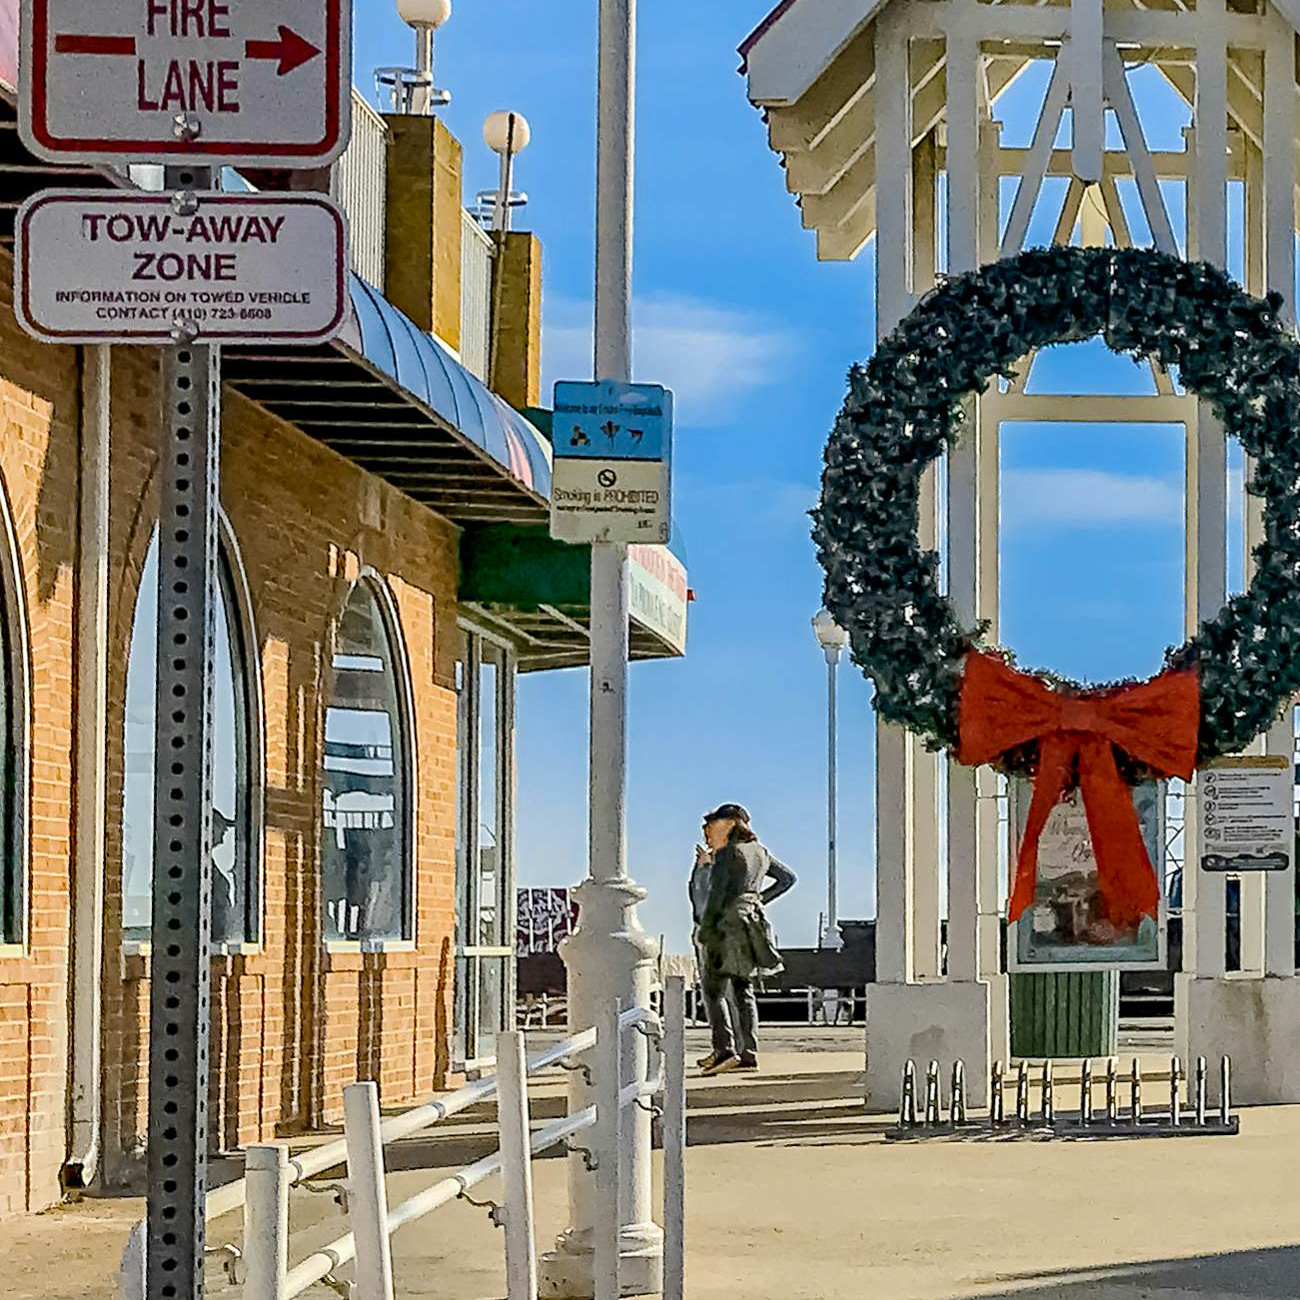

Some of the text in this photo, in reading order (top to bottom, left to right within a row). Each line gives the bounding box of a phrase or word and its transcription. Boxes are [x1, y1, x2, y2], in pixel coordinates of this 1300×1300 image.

[136, 60, 240, 113] LANE
[82, 213, 286, 243] TOW-AWAY
[132, 252, 237, 281] ZONE
[56, 290, 311, 305] INFORMATION ON TOWED VEHICLE
[95, 307, 170, 320] CONTACT
[172, 307, 207, 320] (410)
